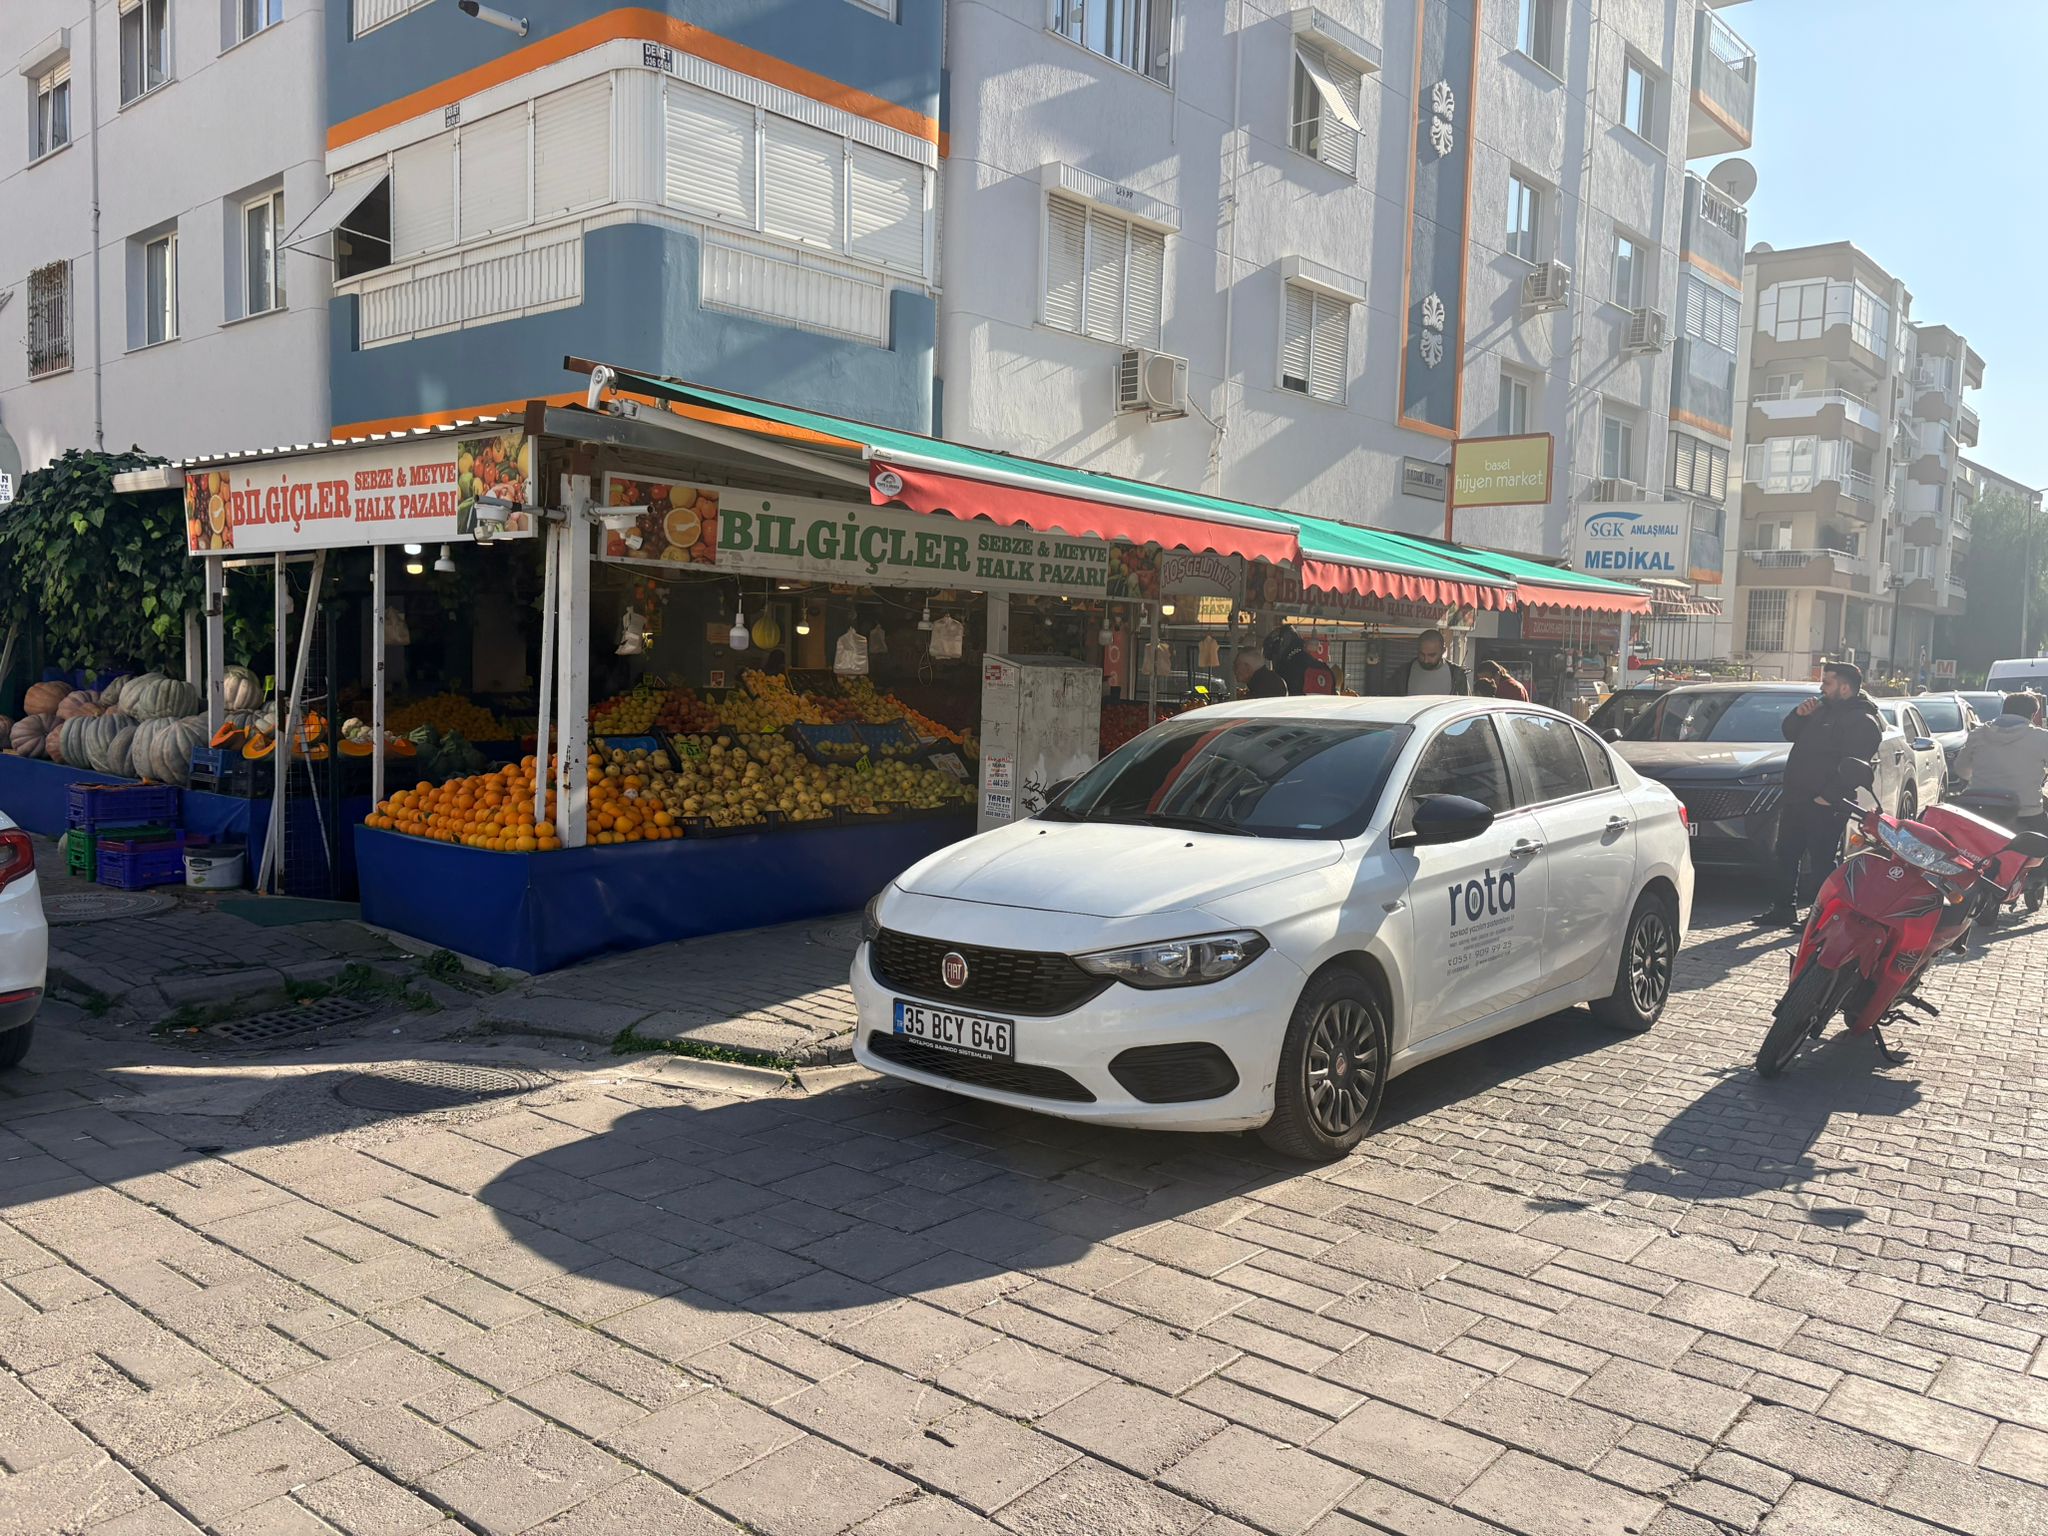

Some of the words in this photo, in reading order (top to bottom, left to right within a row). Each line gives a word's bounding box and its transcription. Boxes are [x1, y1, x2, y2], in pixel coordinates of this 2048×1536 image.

[355, 468, 393, 491] SEBZE
[397, 467, 407, 487] &
[409, 462, 456, 486] MEYVE
[1484, 459, 1511, 471] basel
[1456, 474, 1492, 493] hijyen
[1496, 470, 1544, 487] market
[232, 474, 351, 533] BİLGİÇLER
[355, 495, 396, 522] HALK
[399, 490, 456, 519] PAZARI
[718, 501, 970, 574] BİLGİÇLER
[1590, 522, 1624, 537] SGK
[1630, 525, 1678, 537] ANLAŞMALI
[978, 533, 1033, 555] SEBZE
[1038, 541, 1050, 558] &
[1053, 542, 1107, 562] MEYVE
[1585, 547, 1675, 570] MEDİKAL
[976, 557, 1034, 582] HALK
[1039, 563, 1107, 587] PAZARI
[1387, 602, 1413, 617] HALK
[1448, 868, 1515, 926] rota
[947, 962, 963, 980] FIAT
[905, 1007, 924, 1035] 35
[932, 1013, 964, 1044] BCY
[972, 1020, 1006, 1052] 646
